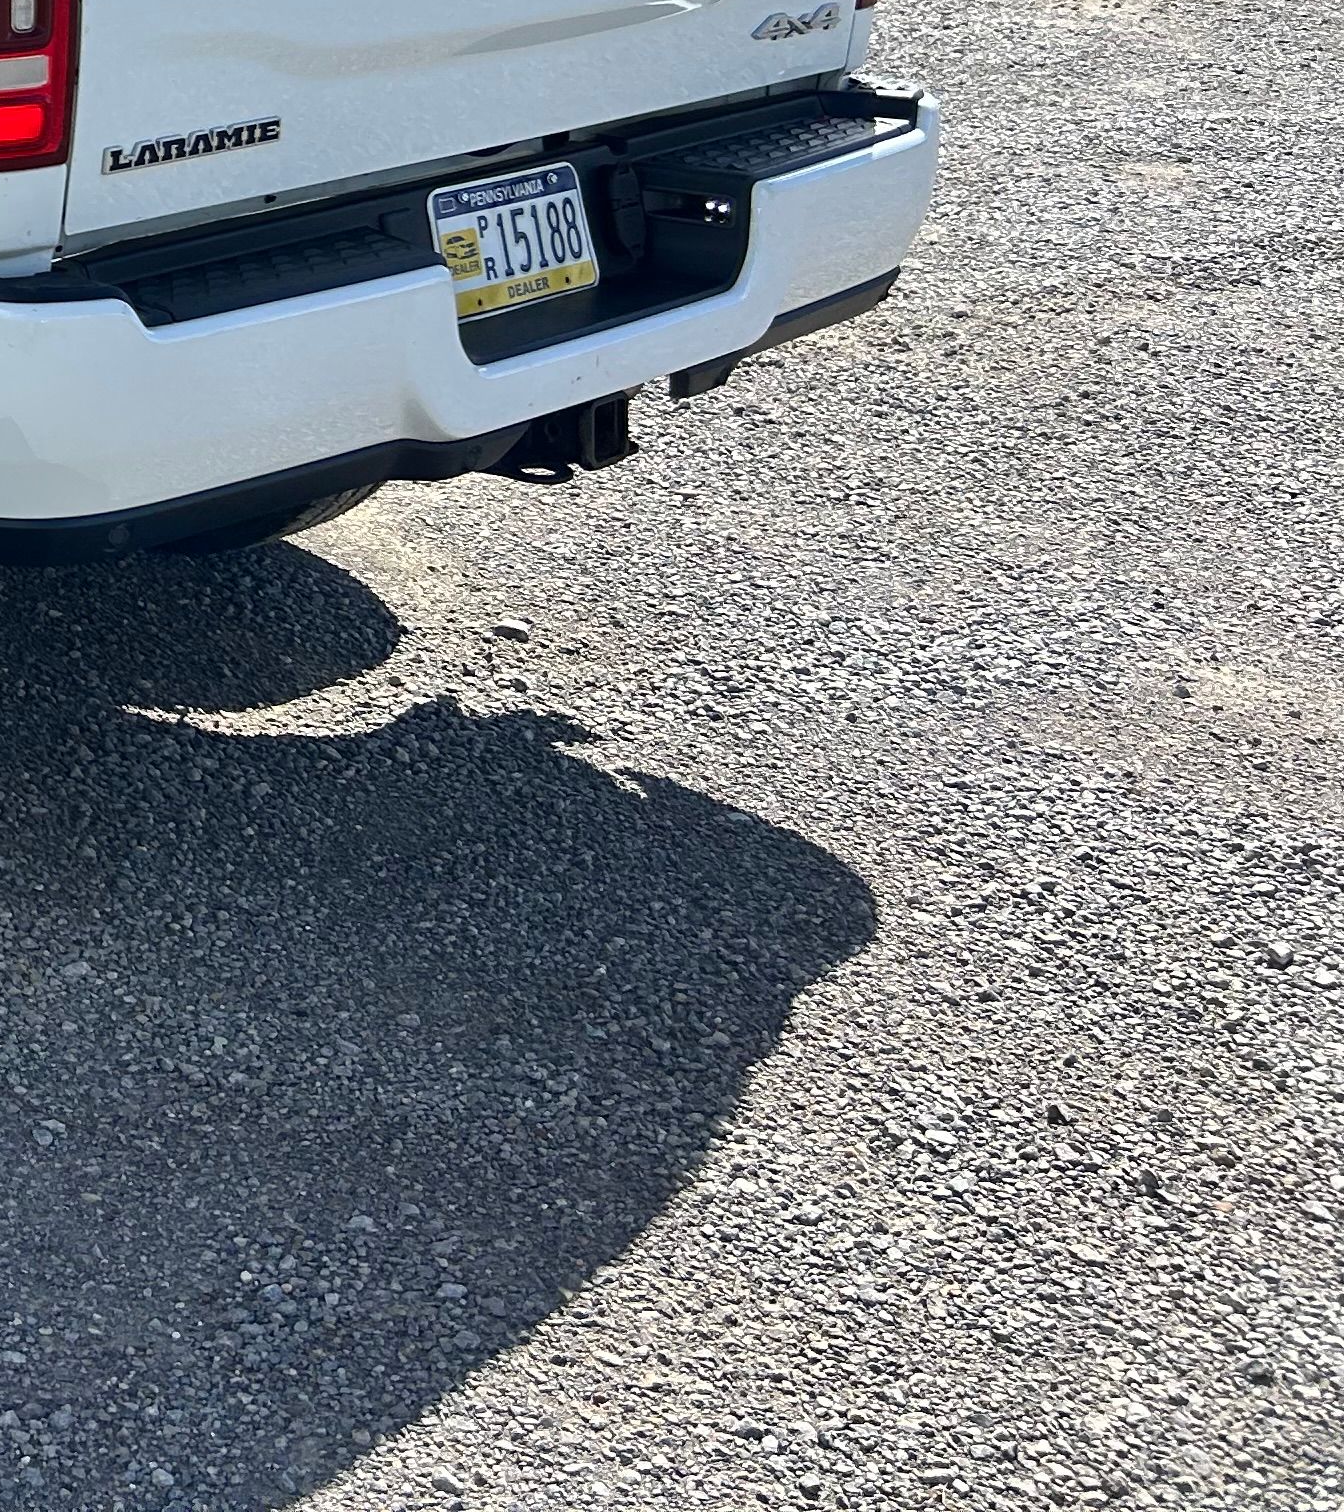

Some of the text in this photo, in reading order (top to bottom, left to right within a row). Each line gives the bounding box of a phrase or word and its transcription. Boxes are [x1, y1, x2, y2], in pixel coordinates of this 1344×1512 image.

[102, 116, 281, 175] LARAMIE
[469, 178, 545, 208] PENNSYLVANIA
[496, 196, 583, 276] 15188
[507, 276, 550, 299] DEALER
